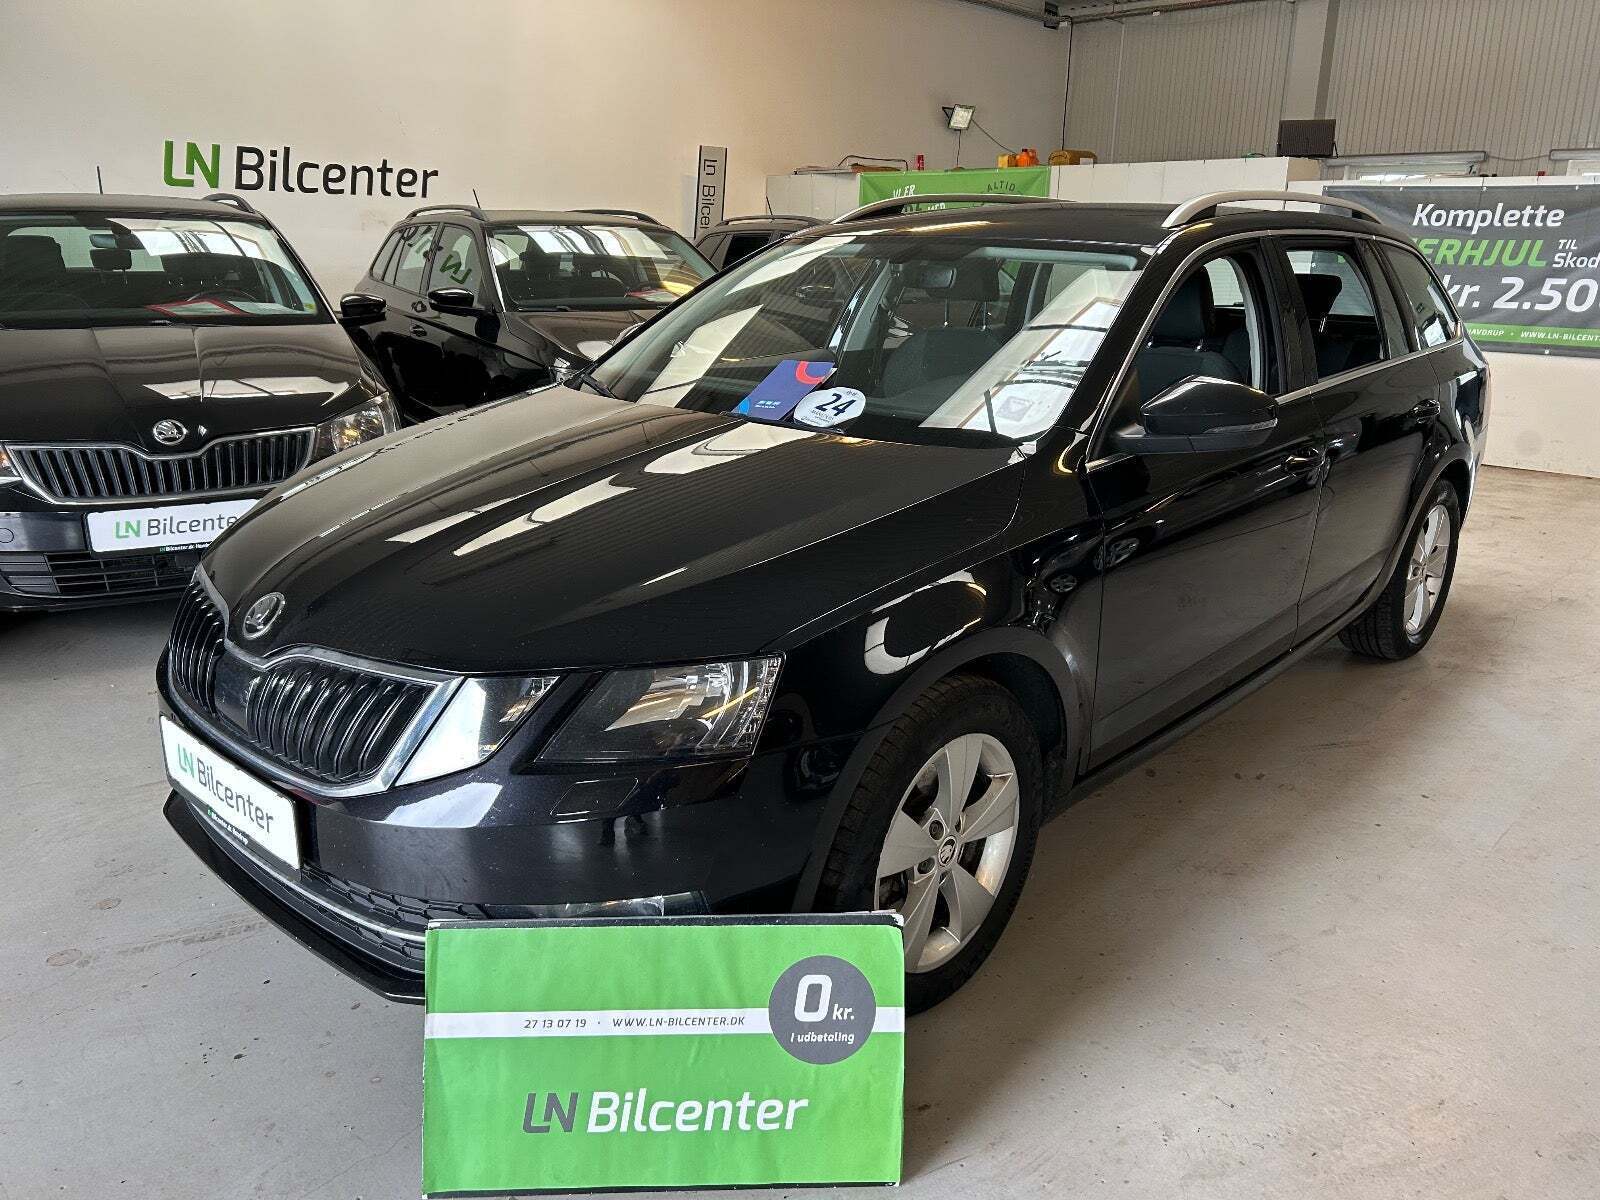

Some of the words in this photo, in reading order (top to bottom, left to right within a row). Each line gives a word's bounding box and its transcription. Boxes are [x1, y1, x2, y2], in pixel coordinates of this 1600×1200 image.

[163, 140, 221, 189] LN
[235, 145, 439, 199] Bilcenter
[987, 180, 1016, 193] ALTID
[699, 185, 716, 229] Bilce
[1412, 203, 1565, 235] Komplette
[1412, 238, 1548, 268] ERHJUL
[1558, 239, 1578, 250] TIL
[1441, 274, 1481, 308] kr.
[1492, 276, 1600, 313] 2.50
[1520, 330, 1600, 342] WWW.LN-BILCENT
[815, 392, 857, 417] 24
[115, 519, 141, 539] LN
[177, 743, 195, 780] LN
[196, 757, 275, 833] Bilcenter
[794, 974, 833, 1022] 0
[832, 1003, 855, 1021] kr.
[524, 1019, 538, 1029] 27
[542, 1018, 553, 1028] 13
[557, 1018, 571, 1028] 07
[575, 1018, 587, 1028] 19
[612, 1016, 745, 1028] WWW.LN-BILCENTER.DK
[797, 1031, 855, 1045] udbetaling
[522, 1092, 579, 1134] LN
[586, 1087, 809, 1133] Bilcenter
